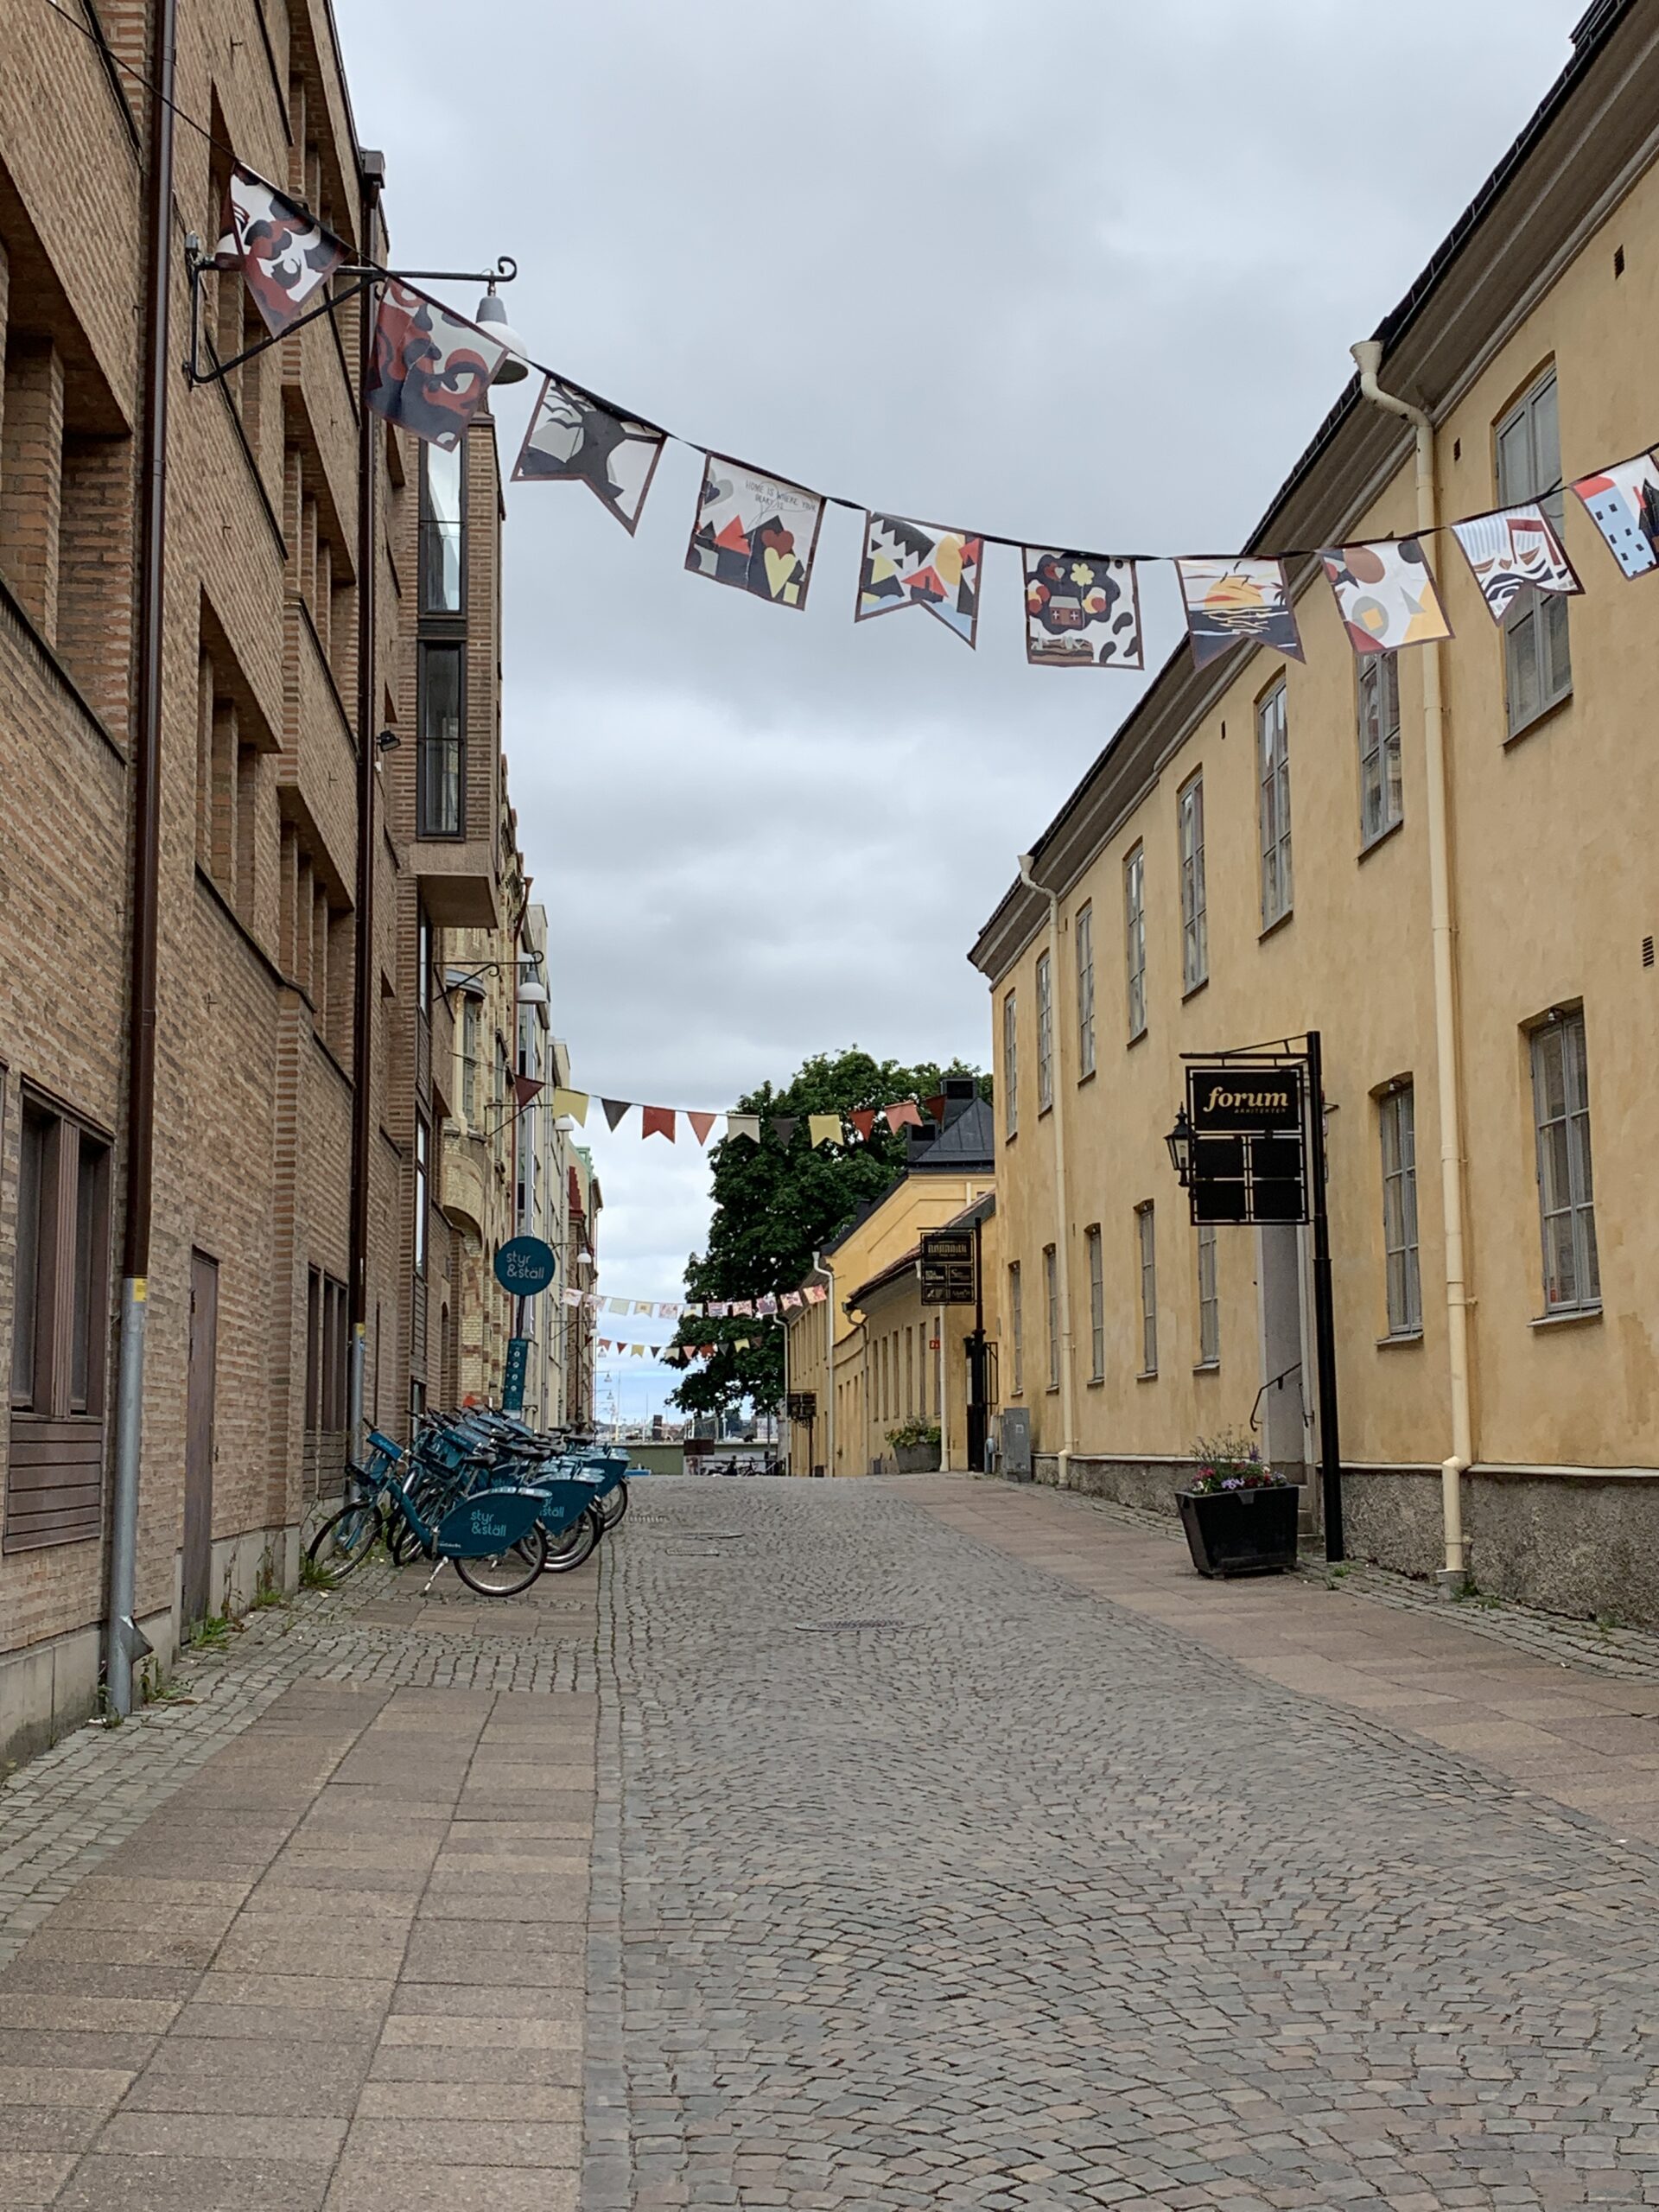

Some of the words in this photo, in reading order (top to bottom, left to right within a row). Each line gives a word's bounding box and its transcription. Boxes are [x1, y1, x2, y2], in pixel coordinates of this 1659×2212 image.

[745, 480, 764, 493] HOME
[767, 487, 774, 497] IS
[1202, 1086, 1289, 1112] forum
[505, 1249, 531, 1268] styr
[506, 1263, 545, 1280] &ställ
[470, 1509, 495, 1525] styr
[539, 1506, 565, 1518] ställ
[471, 1521, 507, 1537] &ställ
